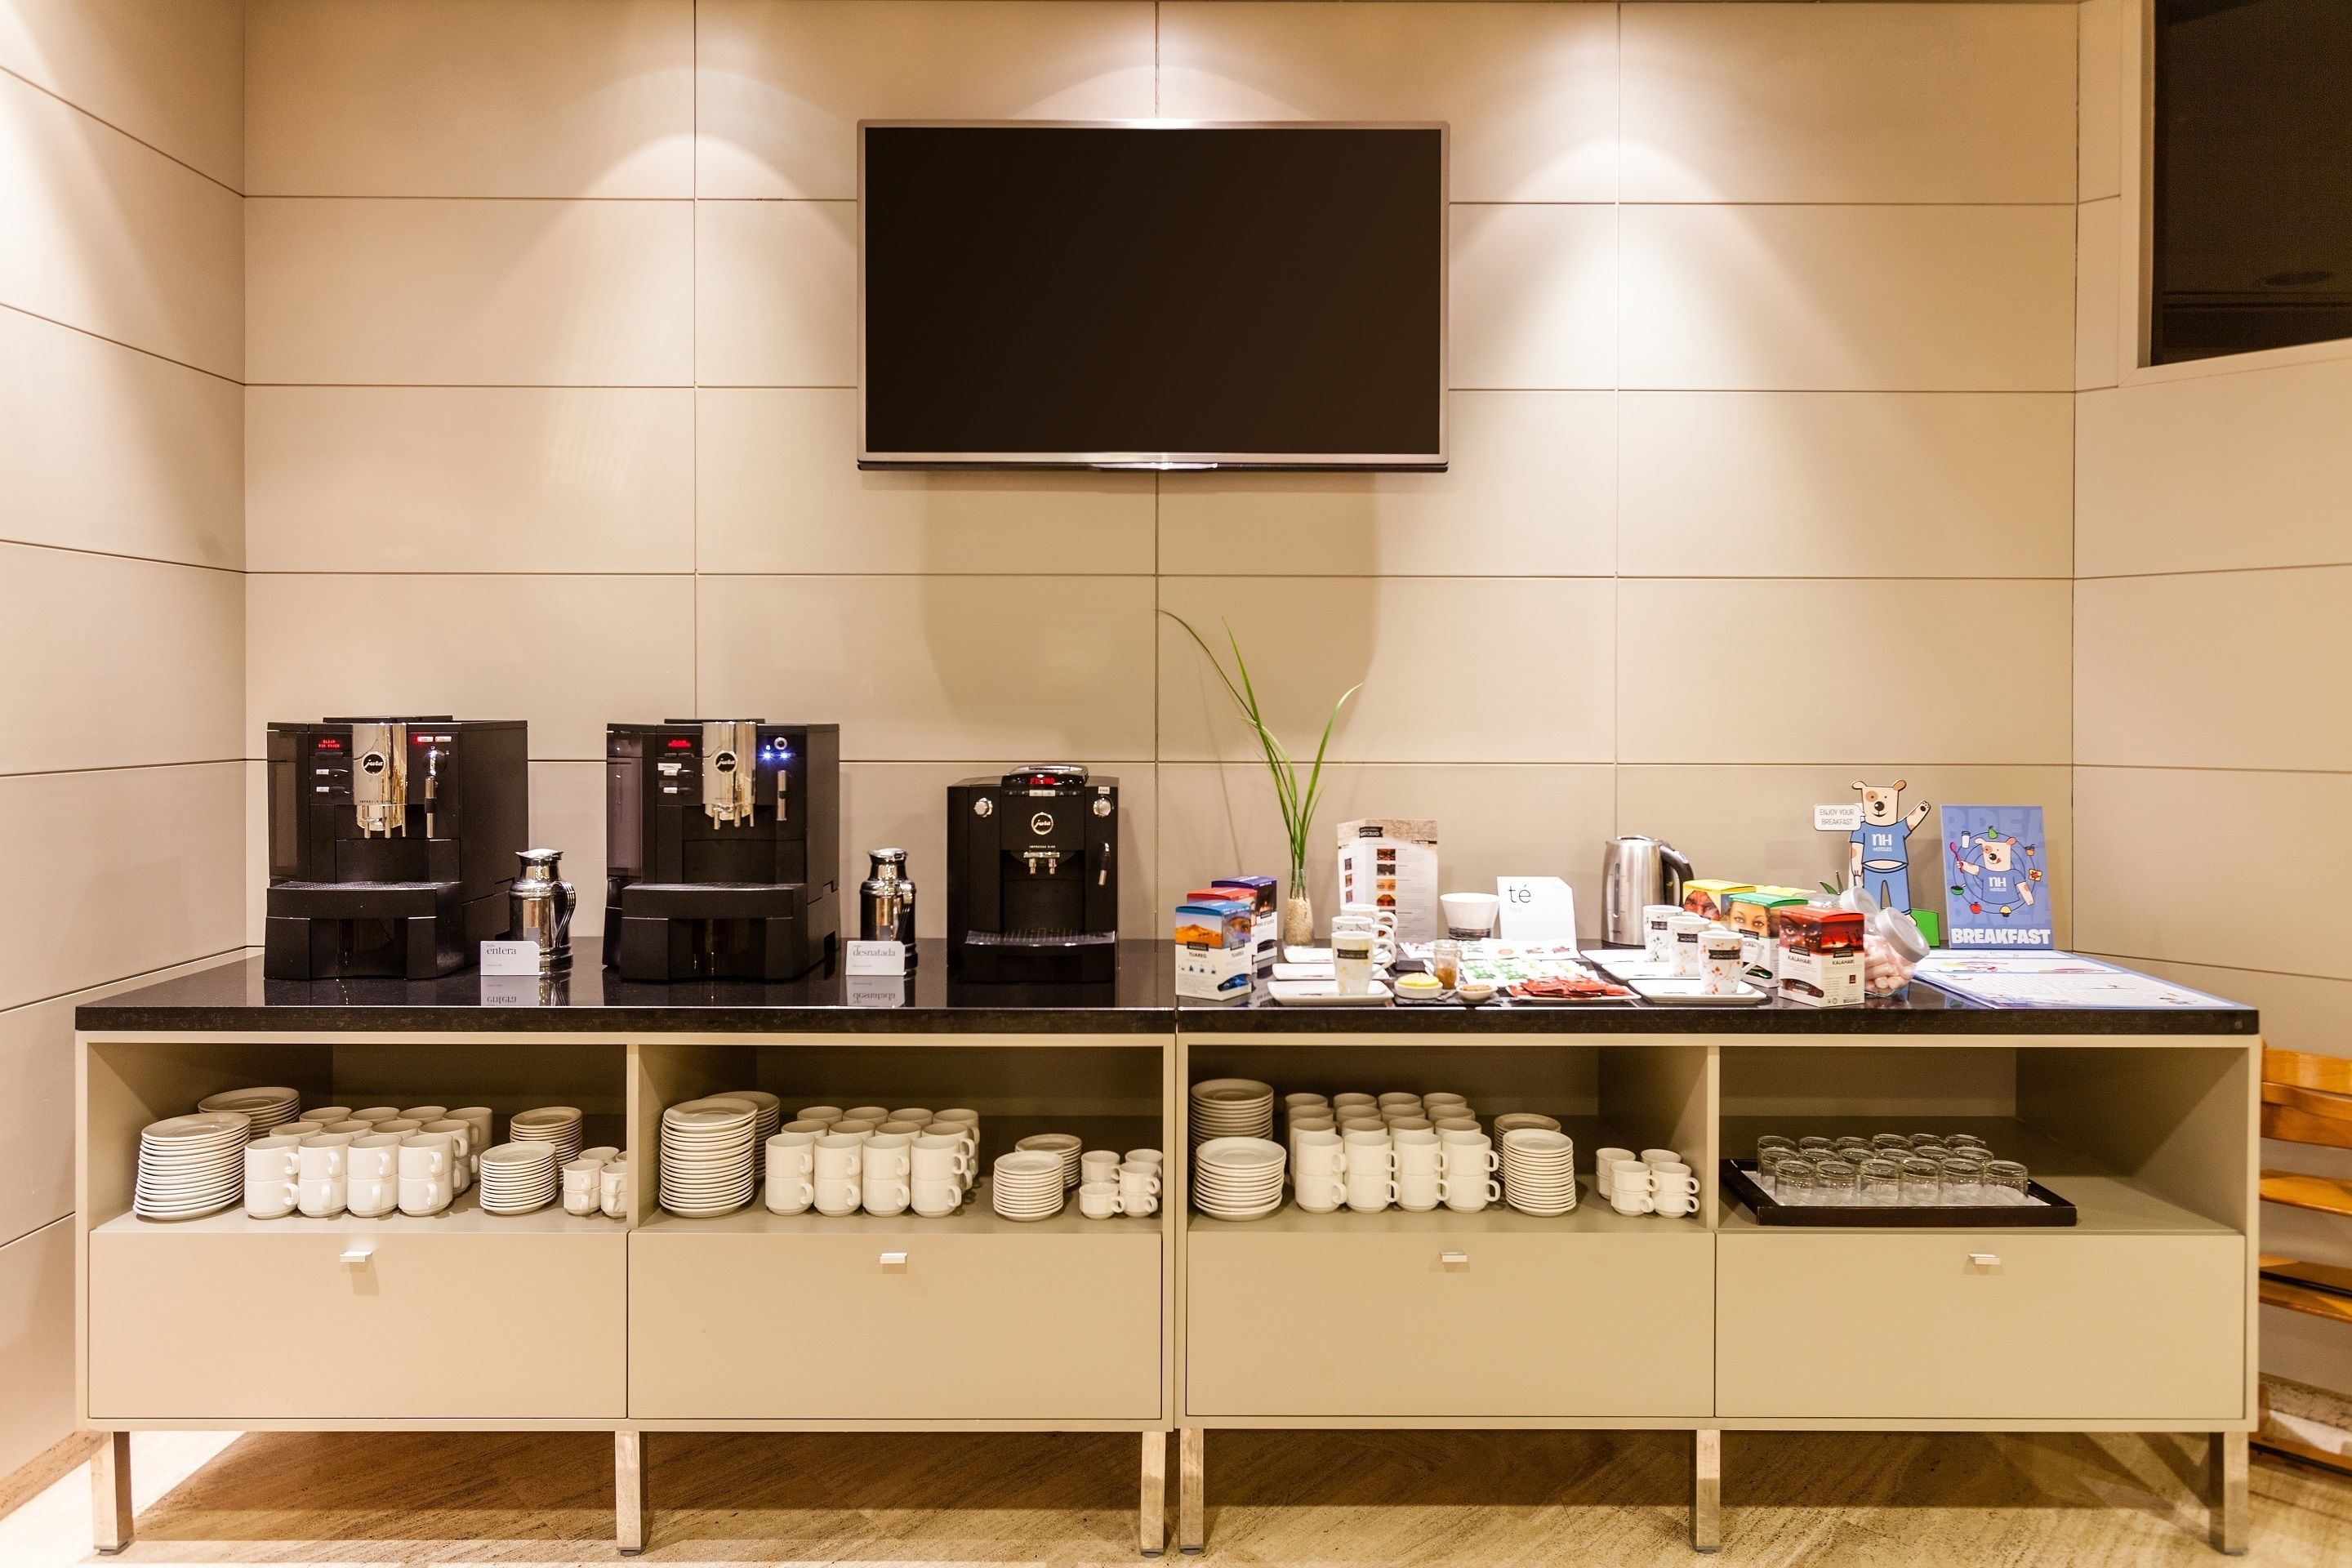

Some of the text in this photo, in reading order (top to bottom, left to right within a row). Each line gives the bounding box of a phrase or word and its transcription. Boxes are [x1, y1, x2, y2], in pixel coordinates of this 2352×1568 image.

[363, 760, 384, 769] jura
[1508, 884, 1531, 903] té
[1950, 928, 2051, 945] BREAKFAST
[486, 947, 517, 955] entera
[853, 947, 896, 957] desnatada
[1788, 956, 1812, 965] KALAHARI
